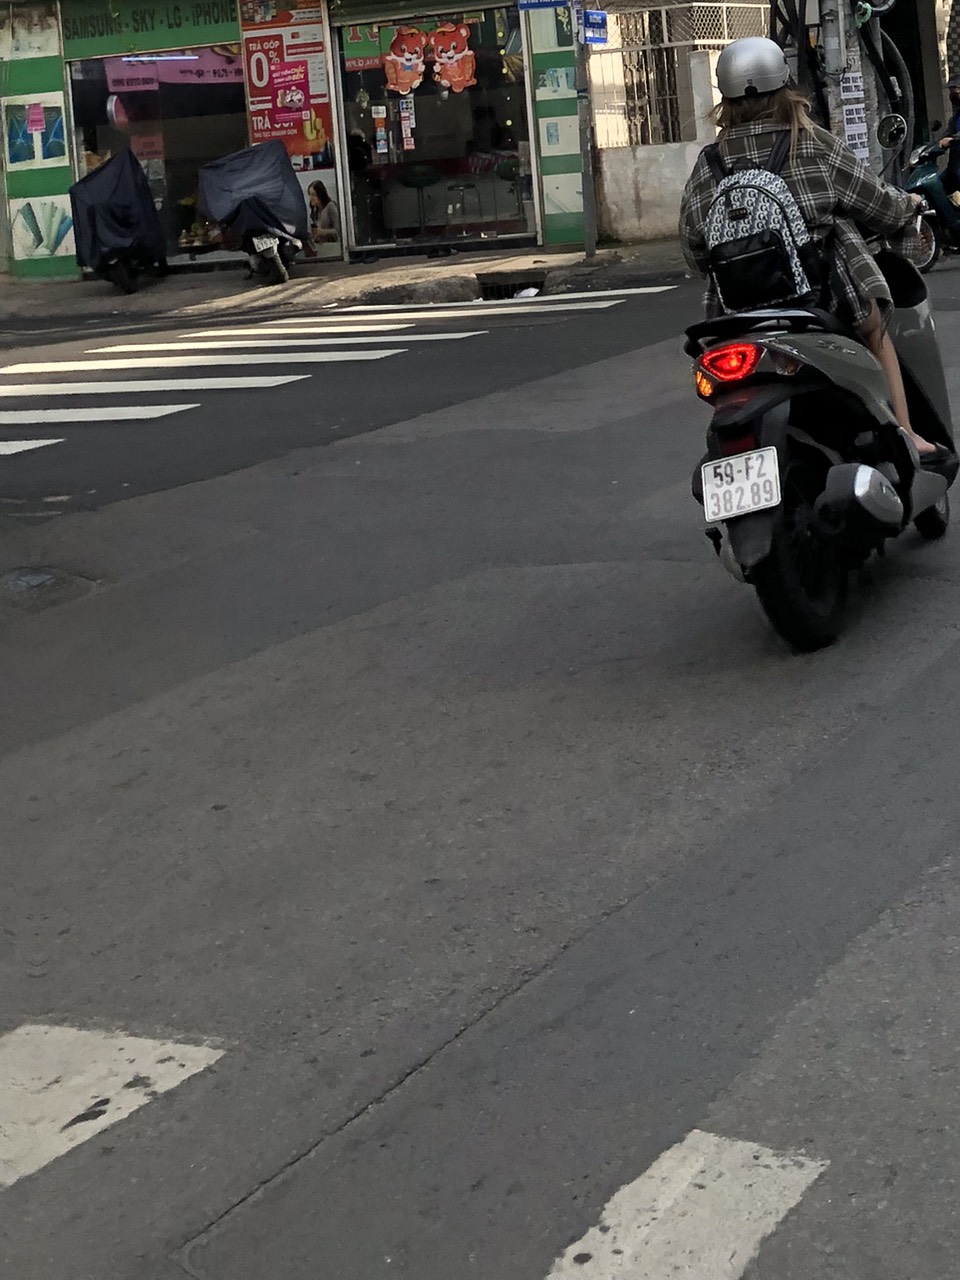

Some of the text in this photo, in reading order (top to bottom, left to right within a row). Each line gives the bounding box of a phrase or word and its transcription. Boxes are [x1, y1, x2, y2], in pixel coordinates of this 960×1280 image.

[131, 7, 156, 33] SKY
[249, 40, 262, 51] TRẢ
[263, 40, 280, 50] GÓP
[252, 110, 271, 130] TRẢ
[713, 453, 766, 489] 59-F2
[710, 479, 774, 517] 382.89
